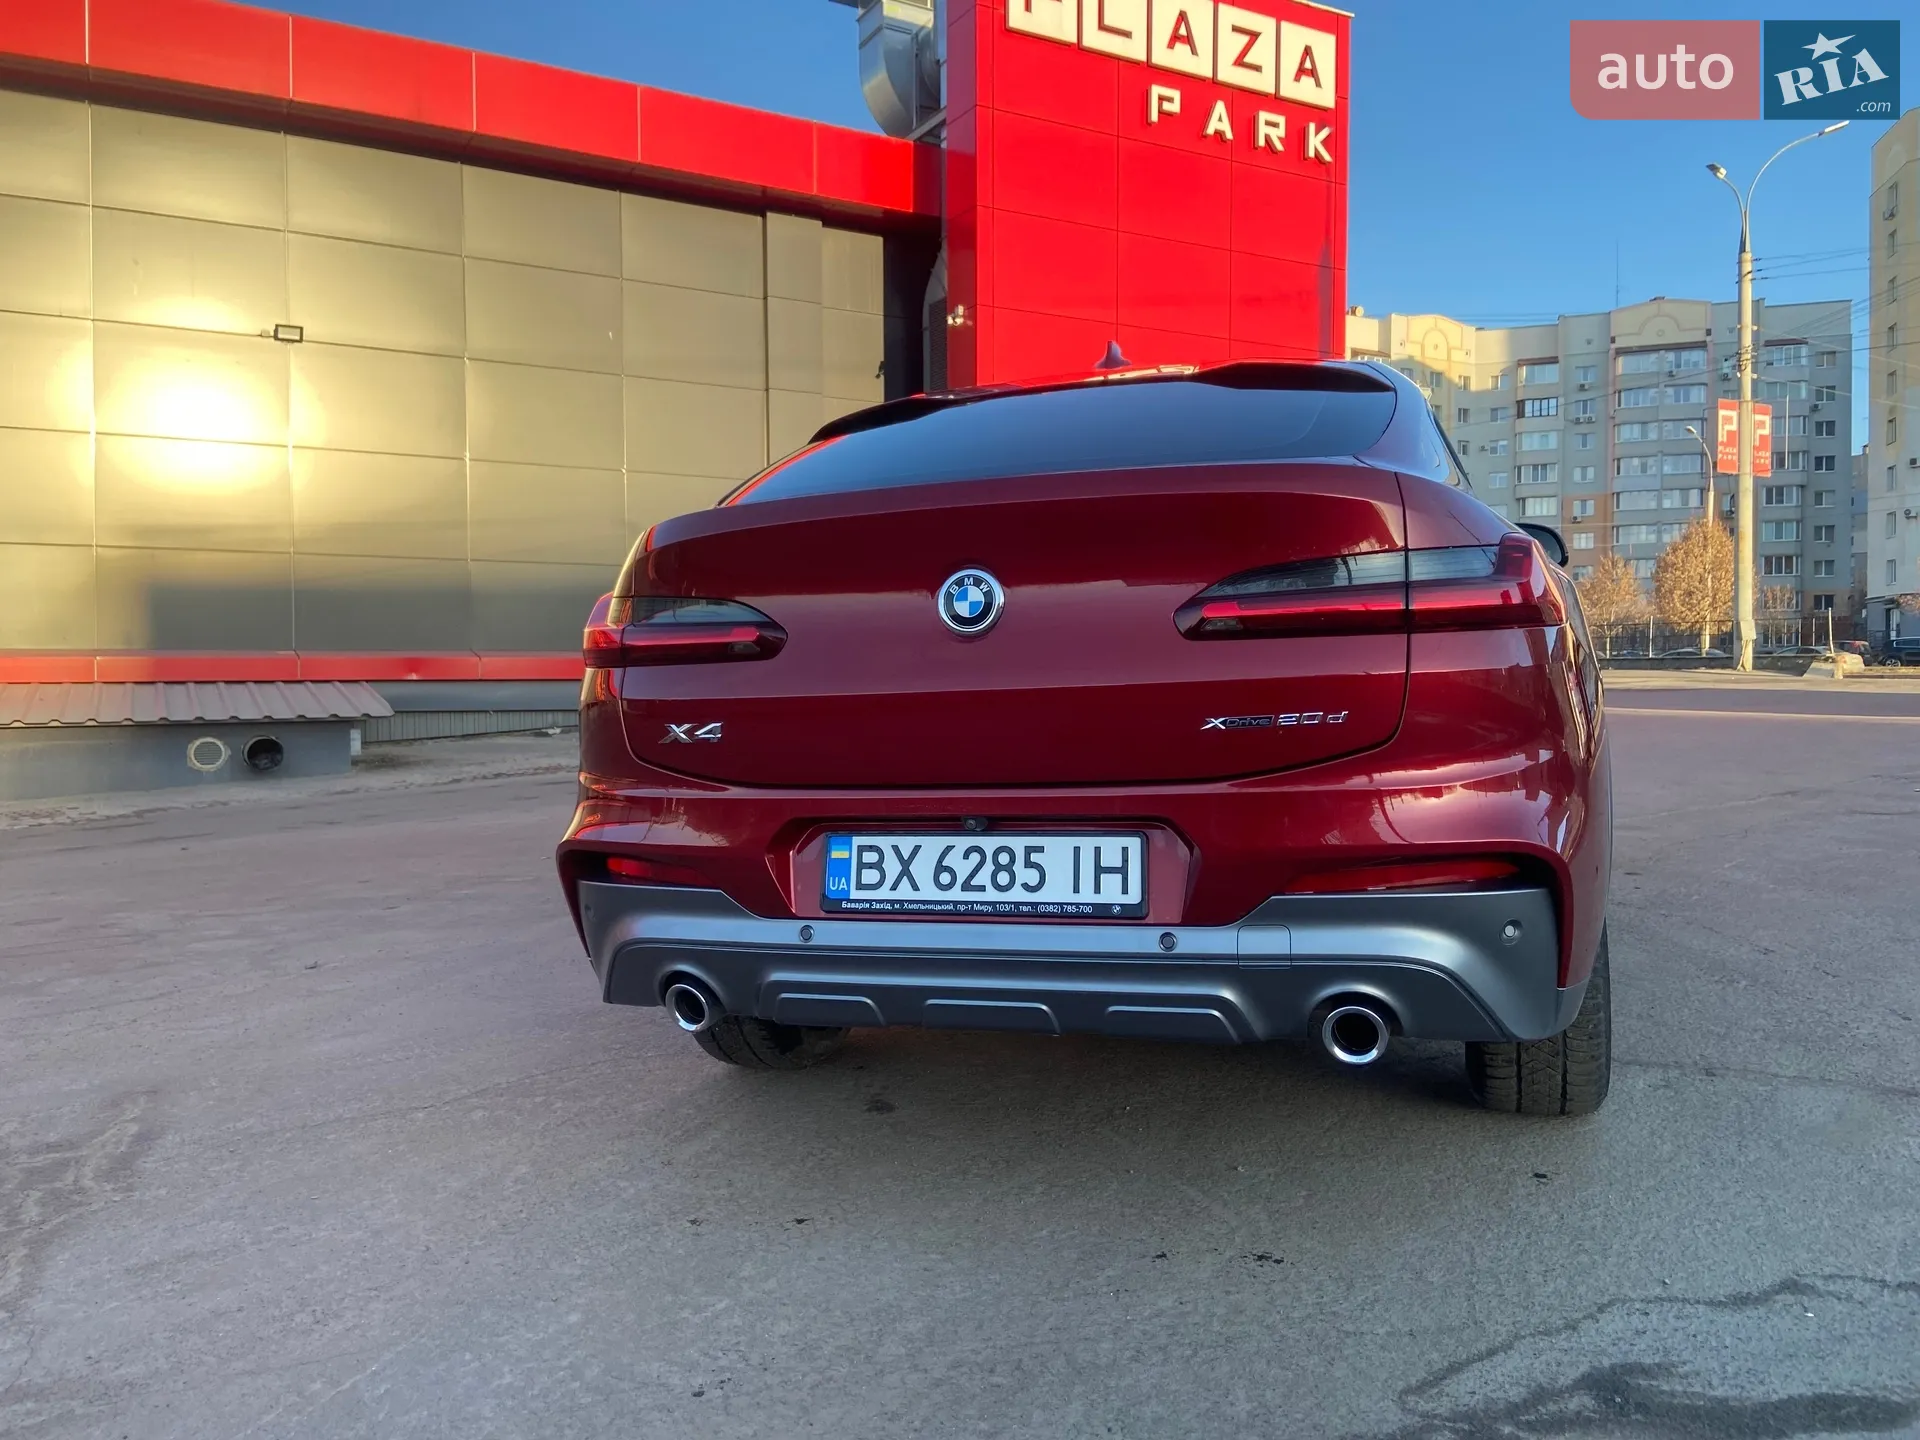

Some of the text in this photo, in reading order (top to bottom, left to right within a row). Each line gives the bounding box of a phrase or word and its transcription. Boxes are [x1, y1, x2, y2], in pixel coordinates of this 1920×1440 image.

[1024, 0, 1323, 89] LAZA
[1147, 84, 1334, 163] PARK
[949, 577, 990, 595] BMW
[658, 722, 723, 744] X4
[855, 845, 1129, 895] BX 6285 IH
[829, 877, 848, 891] UA
[841, 901, 870, 910] Баварія
[871, 901, 893, 910] Захід,
[903, 902, 956, 911] Хмельницький,
[957, 904, 973, 912] пр-т
[973, 903, 994, 912] Миру,
[996, 904, 1017, 912] 103/1,
[1037, 904, 1061, 913] (0382)
[1063, 905, 1093, 913] 785-700
